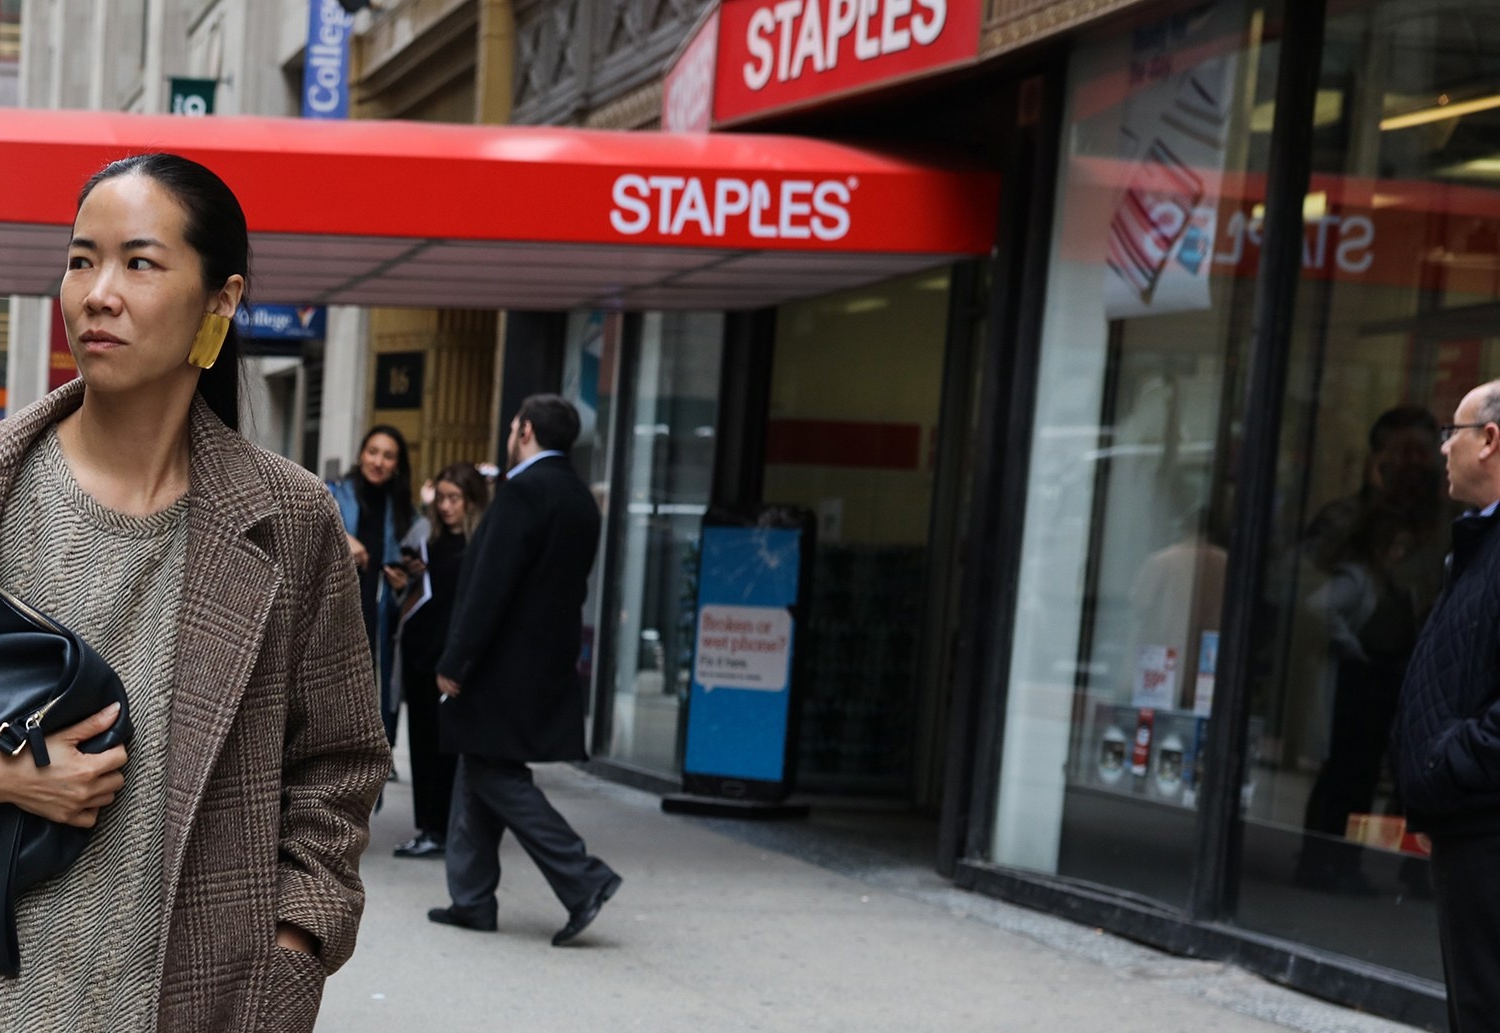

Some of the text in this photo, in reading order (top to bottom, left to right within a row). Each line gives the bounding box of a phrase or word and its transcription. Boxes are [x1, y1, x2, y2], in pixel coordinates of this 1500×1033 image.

[308, 0, 353, 112] Colleg
[743, 0, 948, 91] STAPLES
[609, 174, 851, 241] STAPLES
